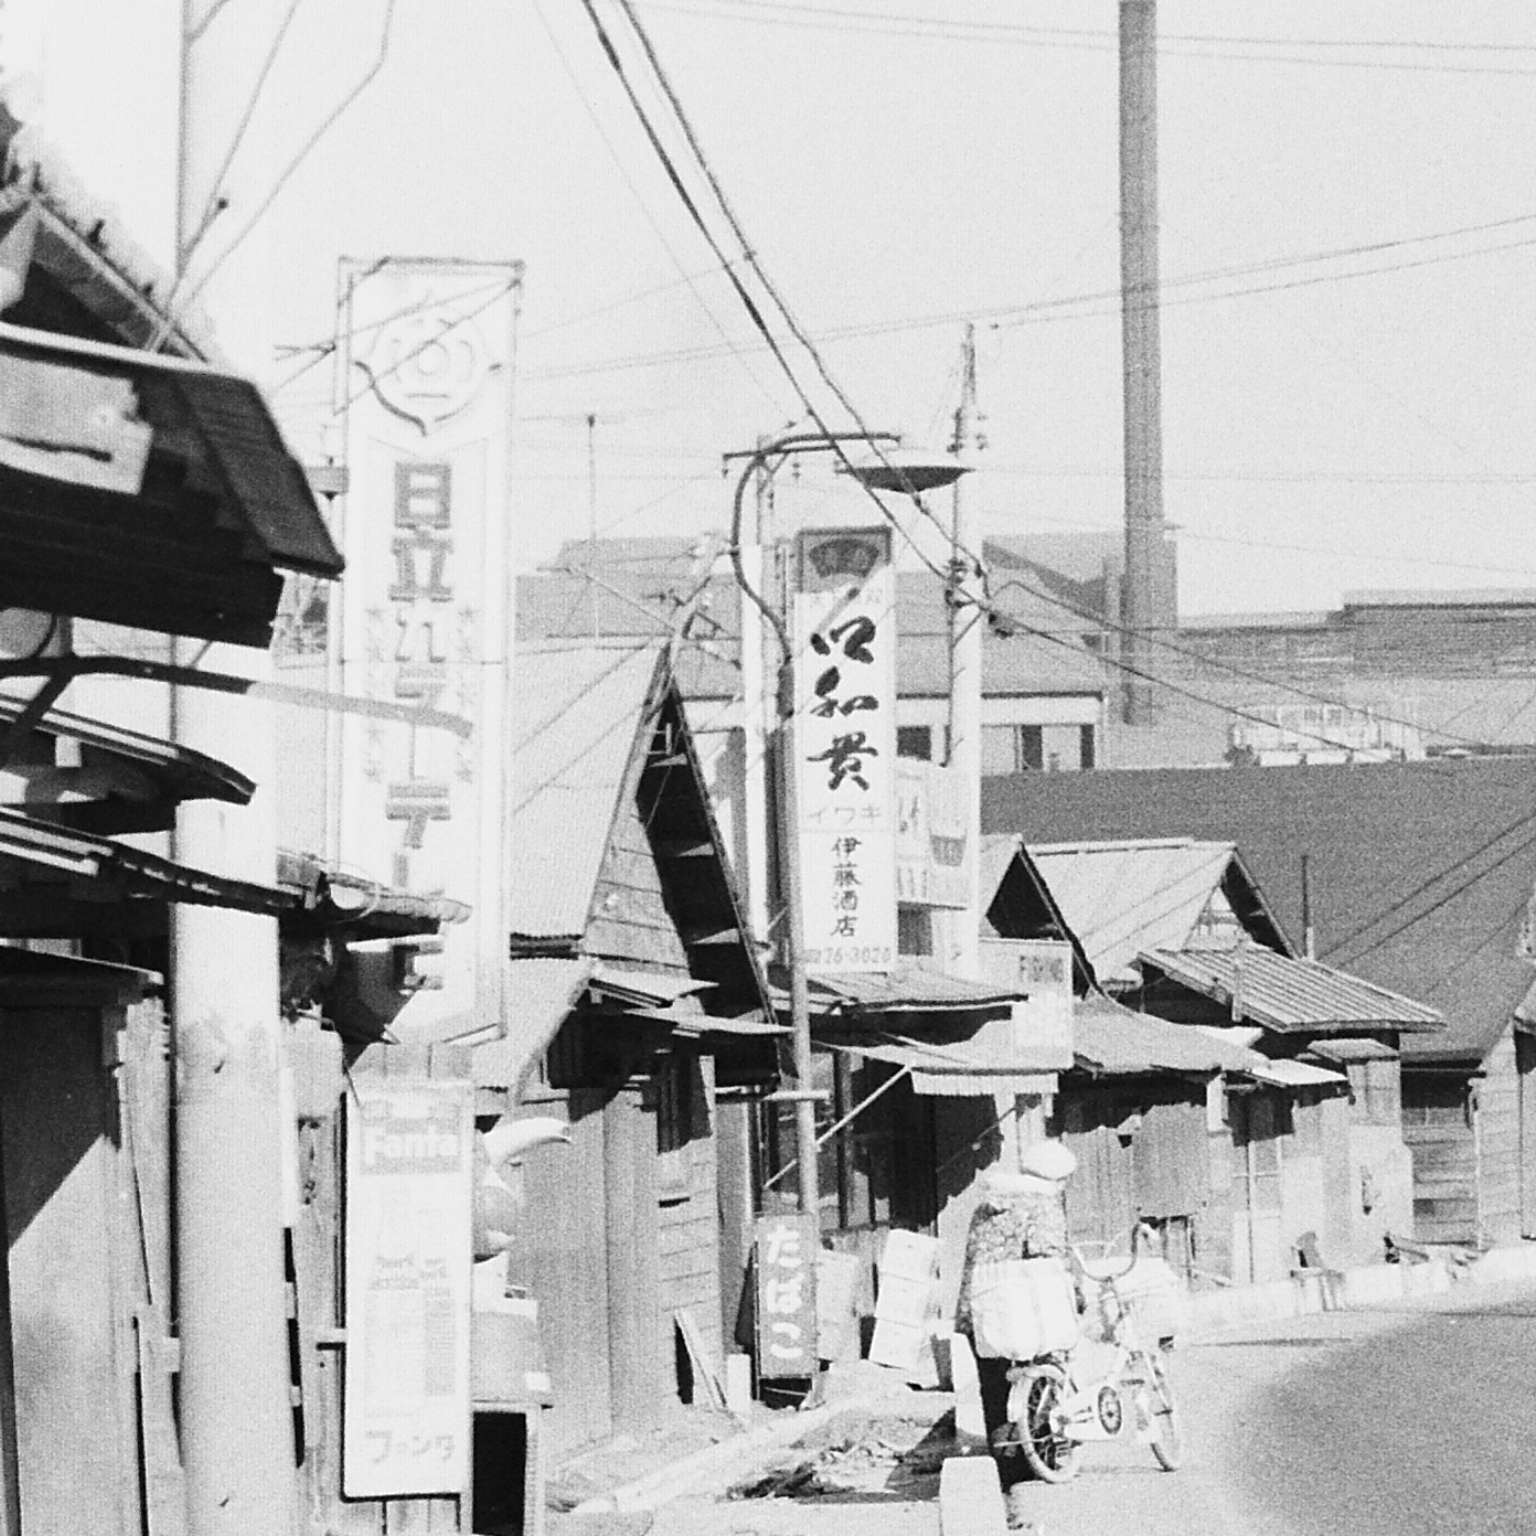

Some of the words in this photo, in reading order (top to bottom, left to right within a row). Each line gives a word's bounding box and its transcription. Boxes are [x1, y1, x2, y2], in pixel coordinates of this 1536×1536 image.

[806, 805, 883, 827] イワキ
[829, 835, 864, 939] 伊藤酒店
[364, 1124, 458, 1164] Fanta
[766, 1221, 805, 1361] たばこ
